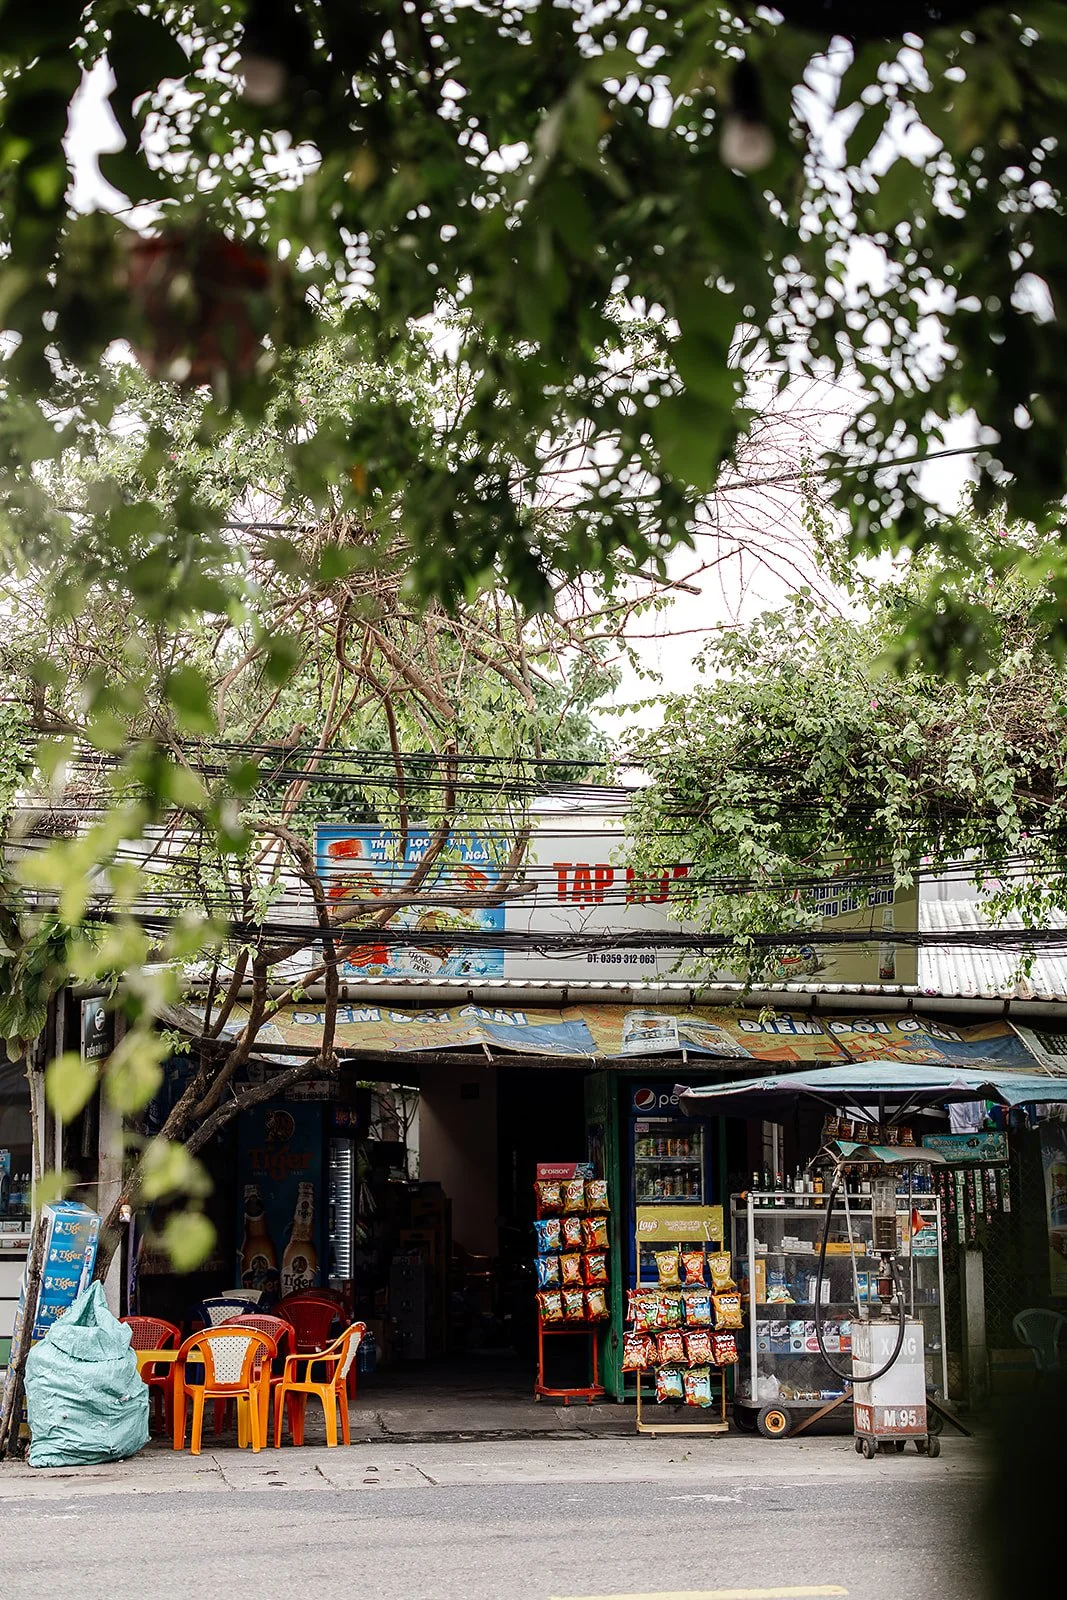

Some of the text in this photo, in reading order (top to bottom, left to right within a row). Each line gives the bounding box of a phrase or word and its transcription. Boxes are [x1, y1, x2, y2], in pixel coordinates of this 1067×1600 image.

[553, 862, 614, 910] TẠP
[867, 889, 894, 907] cứng
[600, 954, 622, 964] 0359
[623, 955, 638, 964] 312
[639, 954, 656, 965] 063
[248, 1145, 314, 1182] Tiger
[59, 1249, 82, 1263] Tiger
[54, 1277, 78, 1291] Tiger
[688, 1297, 707, 1305] POCA
[720, 1297, 739, 1305] POCA
[659, 1369, 678, 1377] POCA
